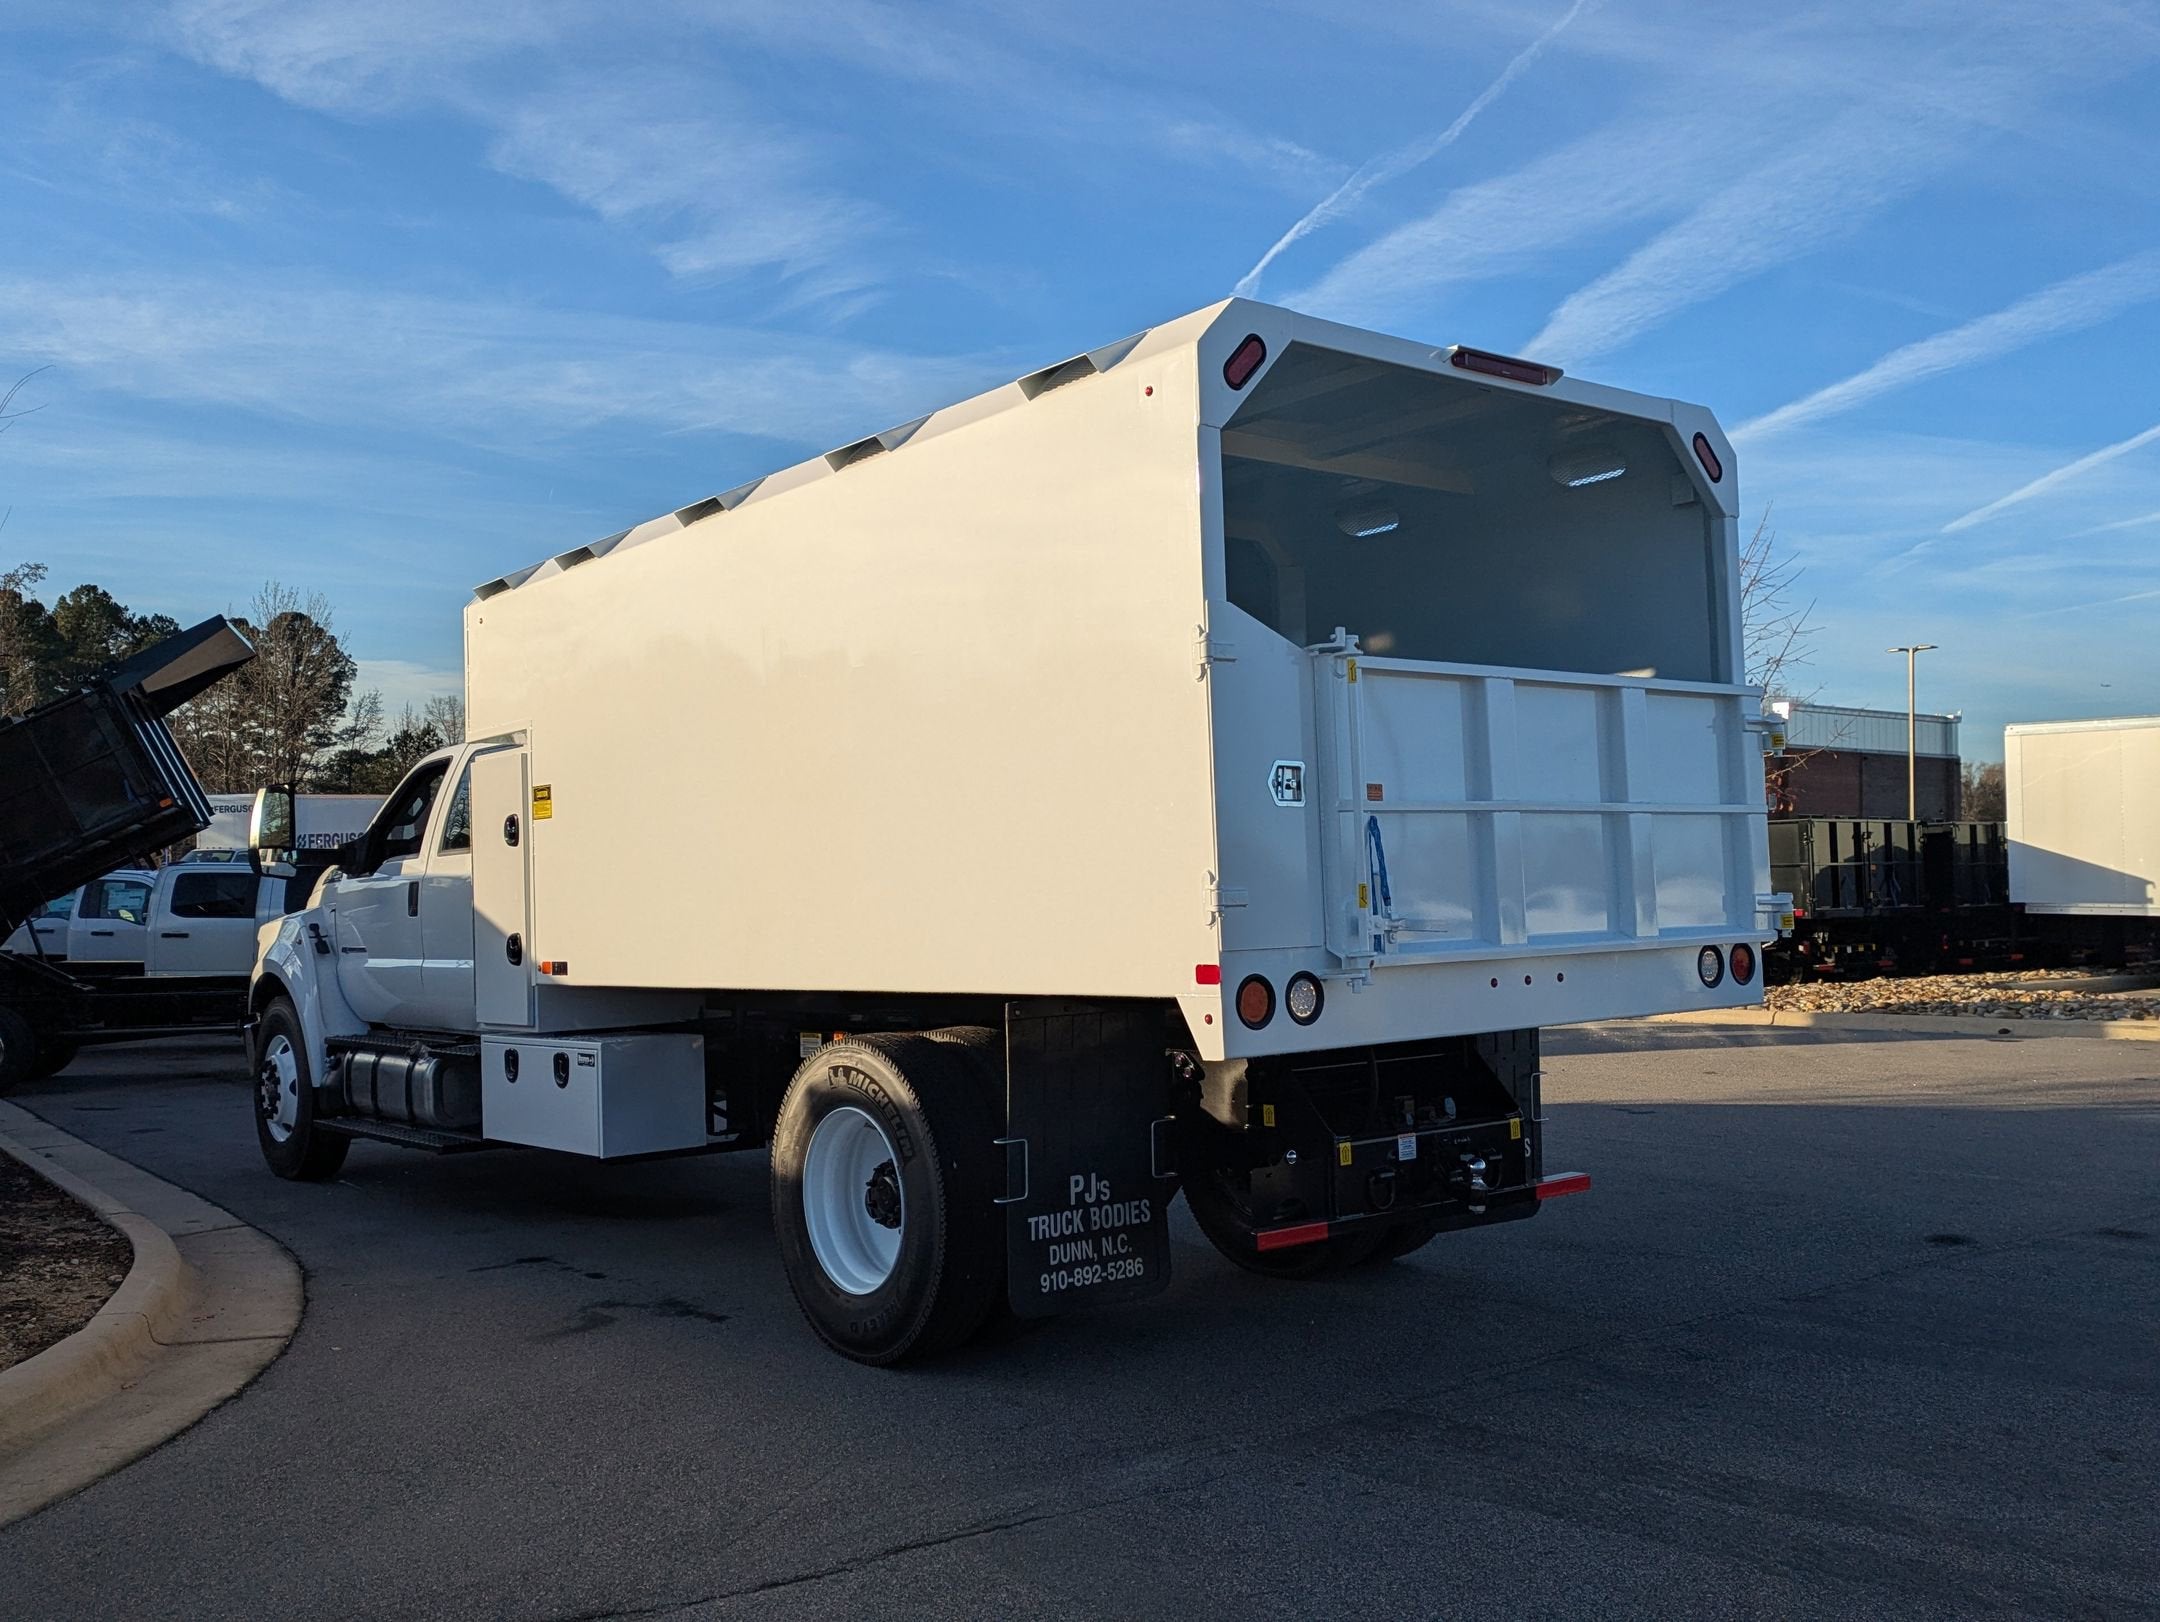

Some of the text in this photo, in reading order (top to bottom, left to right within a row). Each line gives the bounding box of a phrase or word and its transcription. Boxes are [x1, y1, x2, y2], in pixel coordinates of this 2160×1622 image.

[848, 1070, 913, 1157] MICHELIN
[1027, 1198, 1151, 1241] TRUCK BODIES
[1049, 1233, 1133, 1266] DUNN, N.C.
[1040, 1257, 1144, 1293] 910-892-5286
